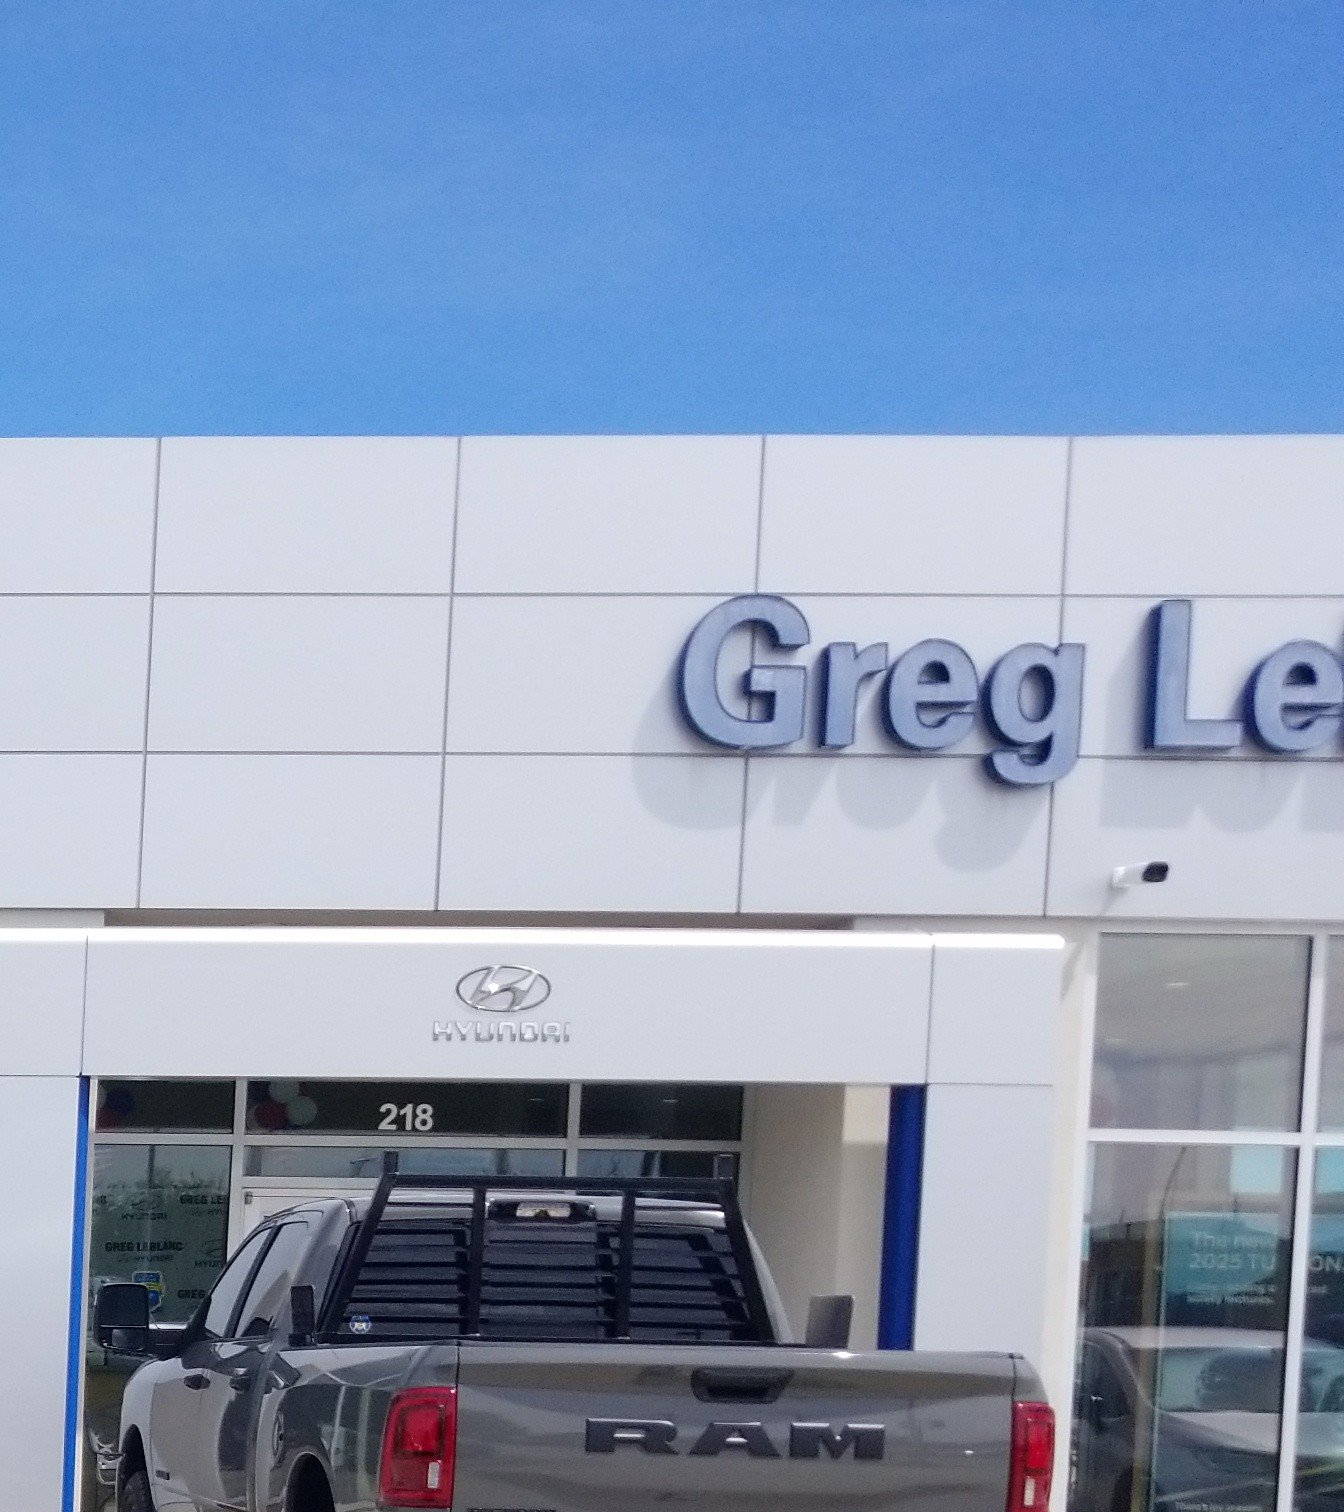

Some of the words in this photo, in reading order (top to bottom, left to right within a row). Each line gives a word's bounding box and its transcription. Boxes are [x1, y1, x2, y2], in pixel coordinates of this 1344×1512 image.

[678, 593, 1087, 787] Greg
[1144, 598, 1344, 754] Le
[431, 1020, 571, 1043] HYUNDAI
[378, 1102, 434, 1131] 218
[585, 1418, 887, 1461] RAM
